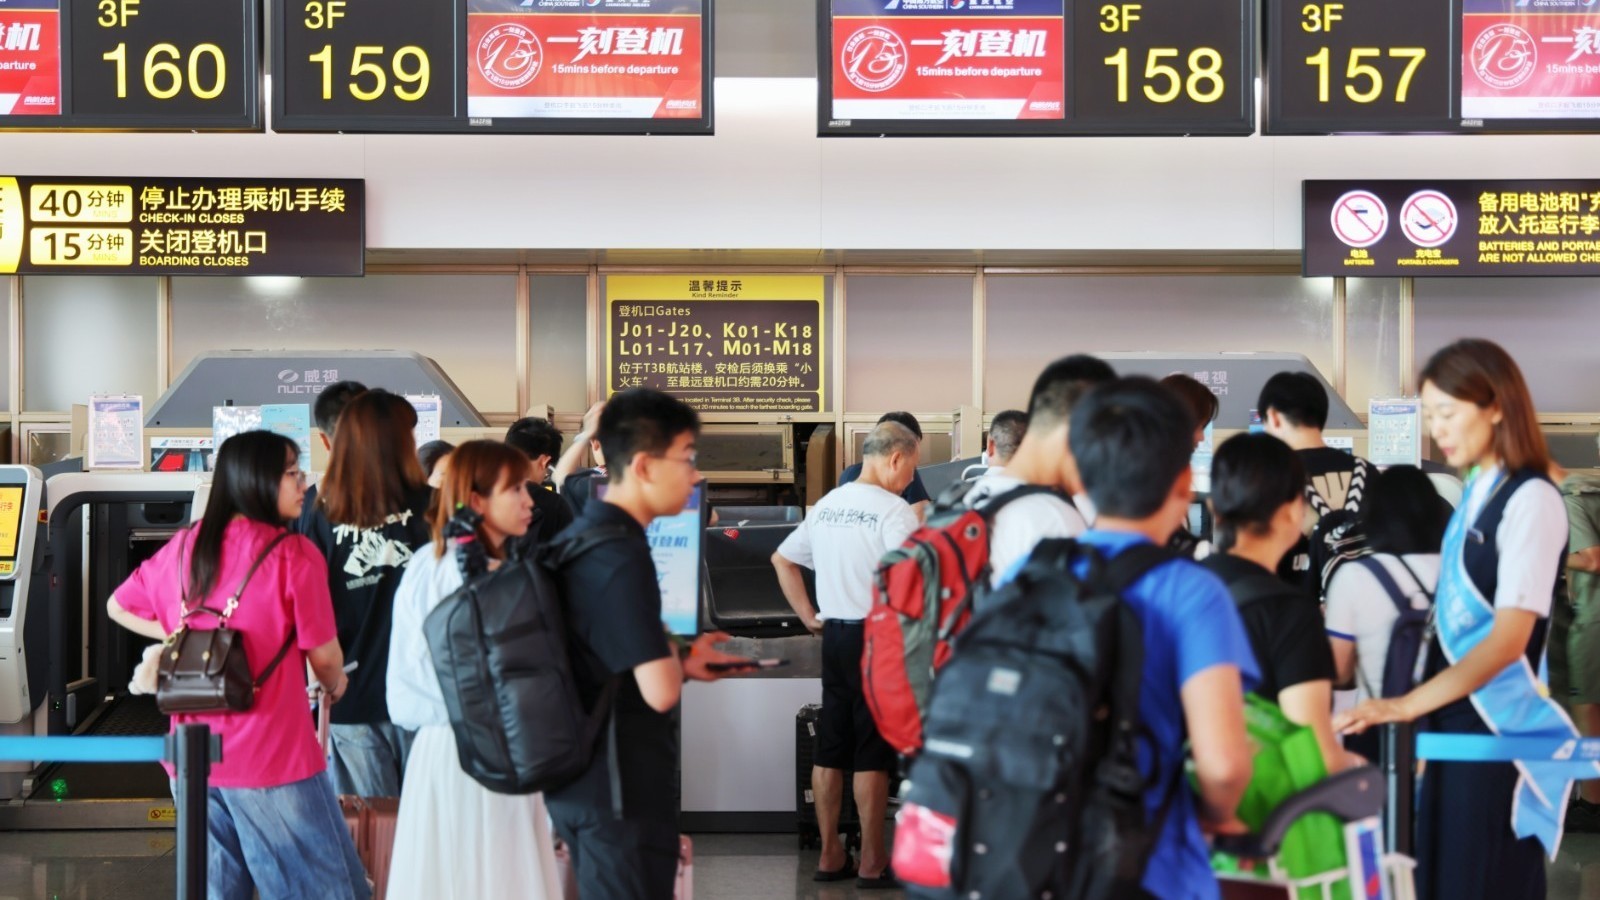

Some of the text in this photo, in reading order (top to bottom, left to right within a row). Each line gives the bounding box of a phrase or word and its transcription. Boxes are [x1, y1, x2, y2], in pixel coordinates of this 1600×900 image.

[98, 0, 140, 27] 3F
[304, 1, 347, 29] 3F
[1099, 4, 1142, 33] 3F
[1301, 4, 1344, 33] 3F
[0, 22, 41, 51] 机
[546, 26, 685, 64] 一刻登机
[910, 29, 1048, 66] 一刻登机
[102, 42, 227, 99] 160
[308, 44, 431, 101] 159
[552, 63, 589, 74] 15mins
[590, 63, 625, 74] before
[626, 63, 679, 76] departure
[915, 66, 1042, 78] 15mins before departure
[1103, 47, 1226, 103] 158
[1304, 47, 1427, 103] 157
[1546, 63, 1600, 73] 15mins be
[38, 189, 125, 217] 40 分钟
[139, 186, 346, 213] 停止办理乘机手续
[139, 213, 245, 224] CHECK-IN CLOSES
[1478, 214, 1600, 235] 放入托运行李
[43, 232, 125, 261] 15 分钟
[139, 229, 267, 254] 关闭登机口
[1479, 241, 1535, 251] BATTERIES
[1537, 241, 1560, 251] AND
[139, 256, 249, 267] BOARDING CLOSES
[1343, 258, 1375, 266] BATTERIES
[1350, 249, 1368, 259] 电池
[1397, 258, 1460, 266] PORTABLE CHARGERS
[1415, 249, 1442, 259] 充电宝
[1478, 253, 1500, 263] ARE
[1502, 253, 1524, 263] NOT
[1527, 253, 1577, 263] ALLOWED
[688, 279, 743, 292] 温馨提示
[619, 305, 691, 317] 登机口Gates
[304, 369, 339, 383] 威视
[756, 397, 776, 405] security
[794, 397, 811, 405] please
